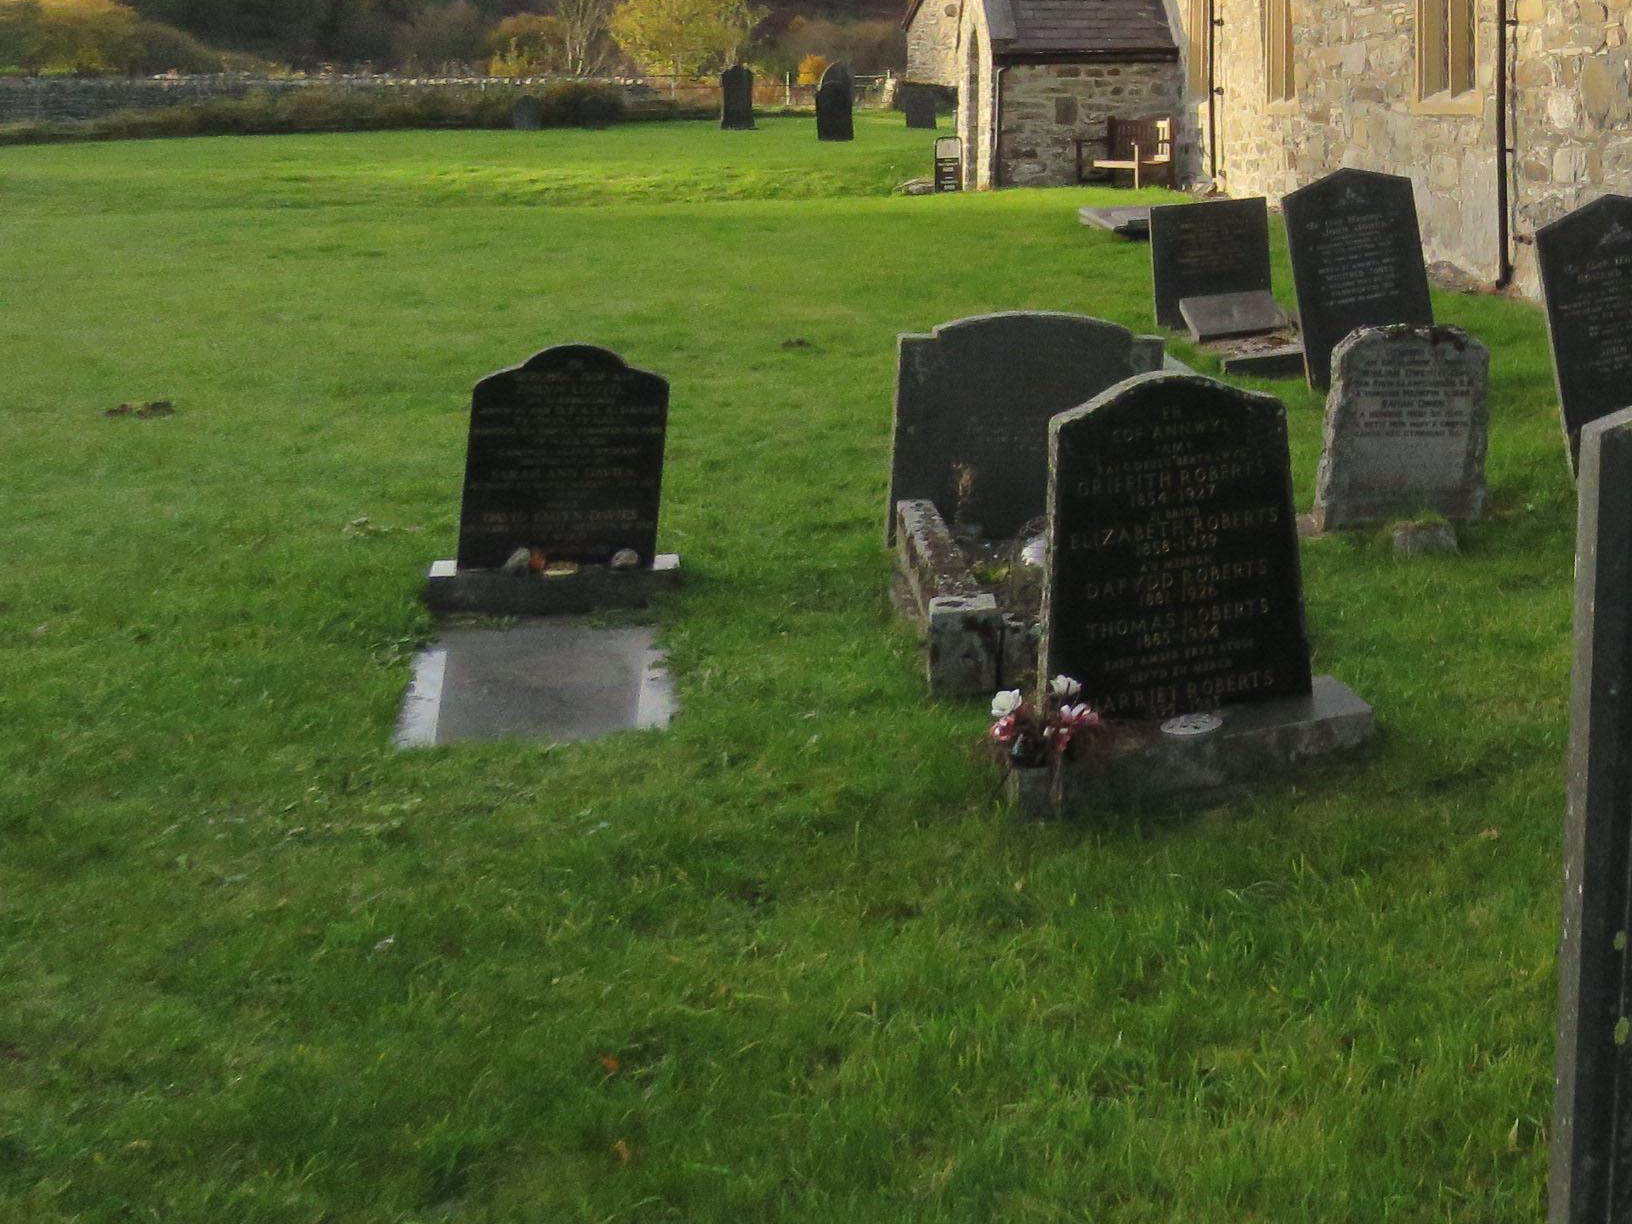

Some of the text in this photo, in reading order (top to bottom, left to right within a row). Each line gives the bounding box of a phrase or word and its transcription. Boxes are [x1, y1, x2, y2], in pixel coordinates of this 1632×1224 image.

[1077, 460, 1267, 497] GRIFFITH ROBERTS
[1070, 506, 1280, 551] ELIZABETH ROBERTS
[1086, 558, 1268, 600] DAFYDD ROBERTS
[1086, 597, 1270, 641] THOMAS ROBERTS
[1186, 669, 1274, 698] ROBERTS
